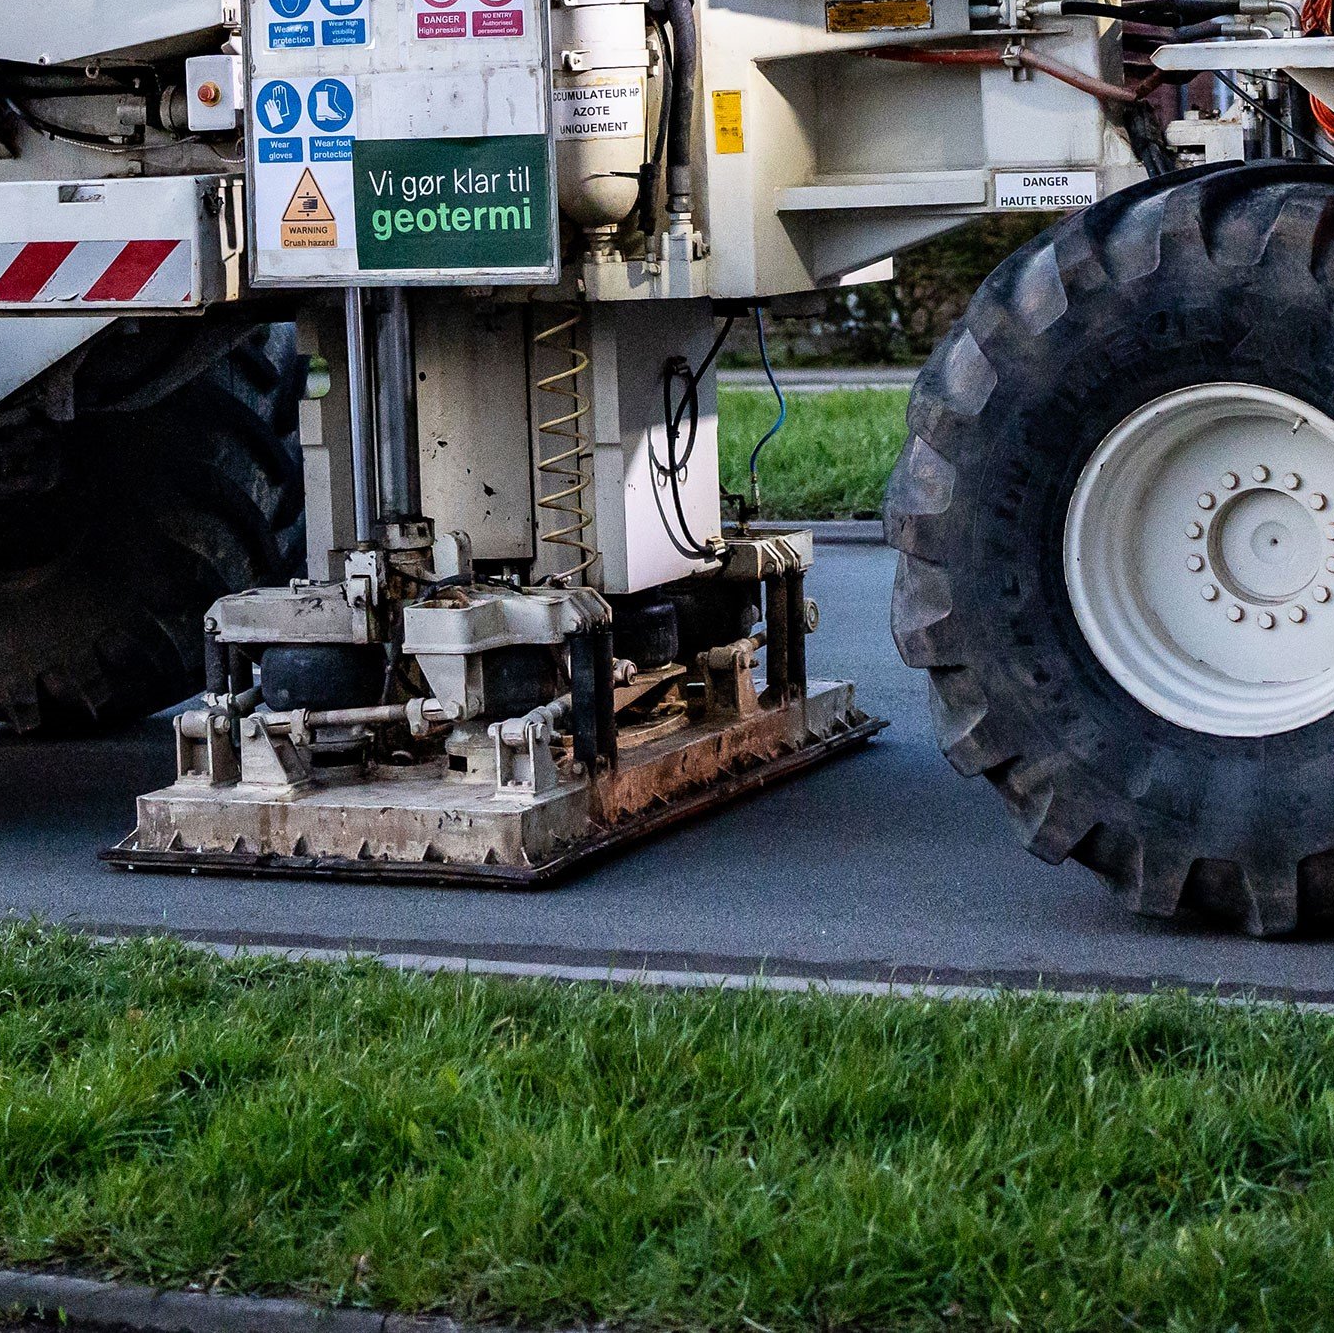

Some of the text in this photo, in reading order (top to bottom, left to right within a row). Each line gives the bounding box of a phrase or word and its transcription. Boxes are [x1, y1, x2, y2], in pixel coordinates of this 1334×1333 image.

[423, 15, 460, 24] DANGER
[419, 27, 465, 35] High pressure
[272, 36, 311, 46] protection
[553, 87, 640, 102] CCUMULATEUR HP
[573, 106, 610, 117] AZOTE
[560, 121, 628, 135] UNIQUEMENT
[270, 141, 290, 149] Wear
[336, 139, 352, 147] foot
[269, 152, 293, 160] gloves
[314, 151, 352, 161] protection
[368, 166, 531, 202] Vi gør klar til
[1023, 176, 1069, 187] DANGER
[1000, 195, 1092, 206] HAUTE PRESSION
[372, 197, 532, 241] geotermi
[289, 226, 328, 234] WARNING
[284, 239, 335, 247] Crush hazard
